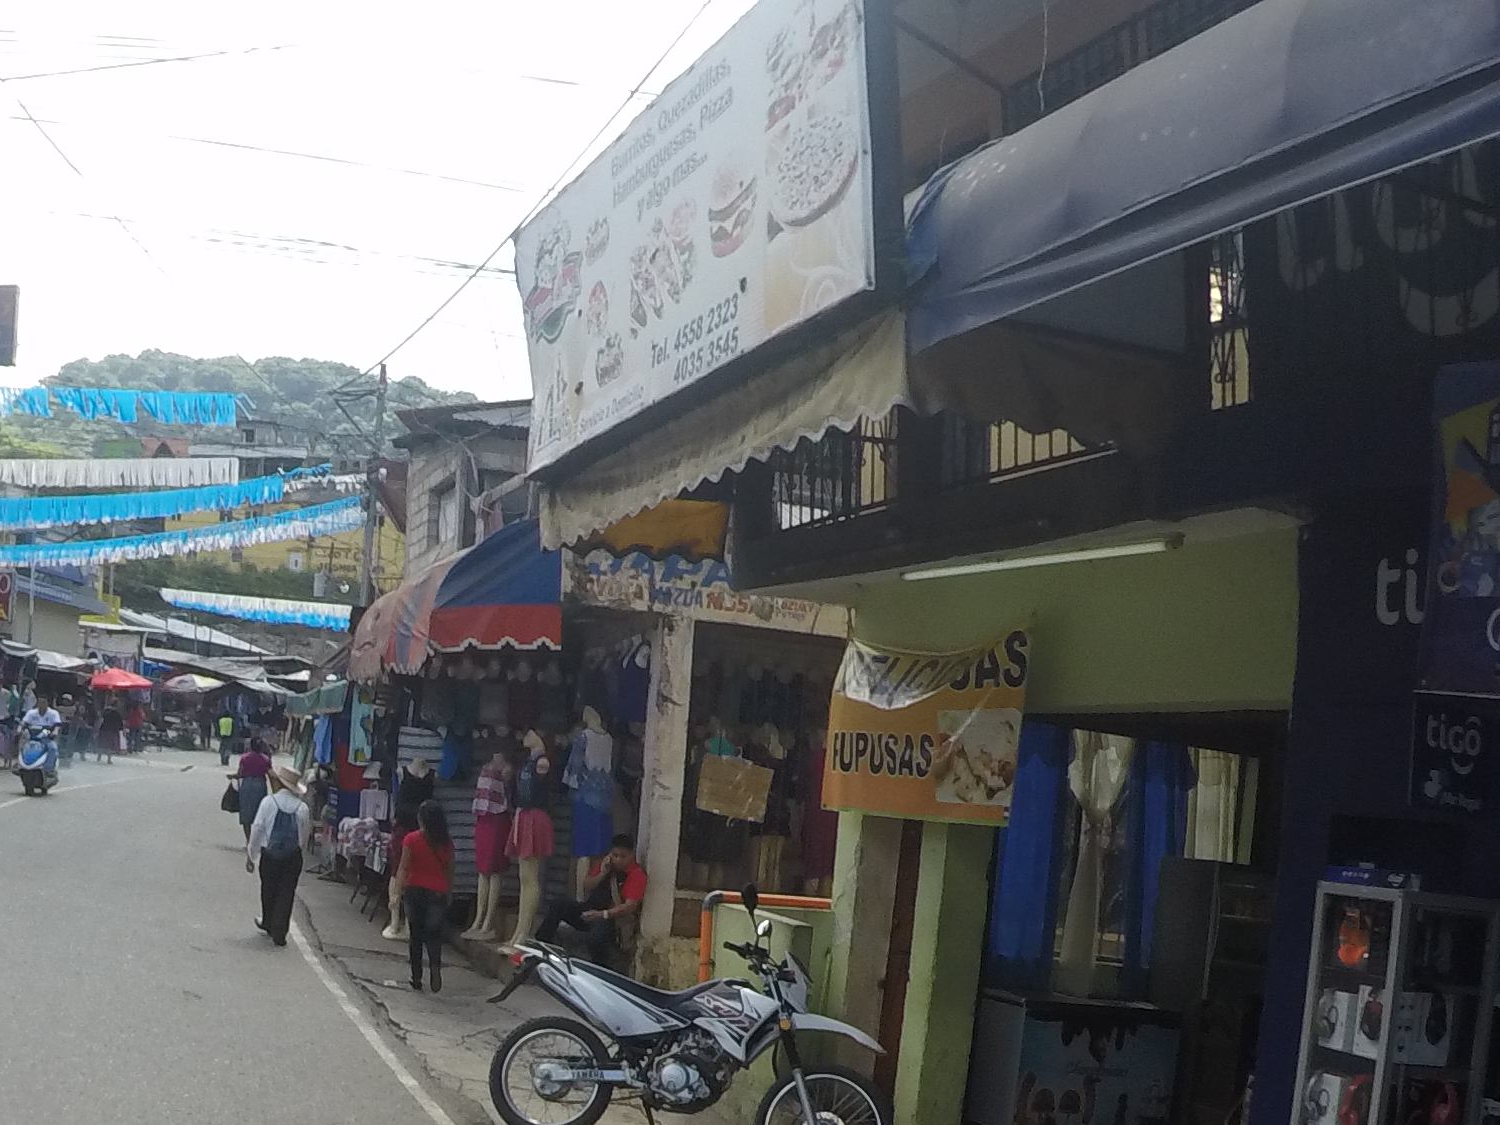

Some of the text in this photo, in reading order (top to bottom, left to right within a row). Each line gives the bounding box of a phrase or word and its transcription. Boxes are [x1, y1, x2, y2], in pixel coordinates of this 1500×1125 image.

[674, 313, 704, 352] 4558
[706, 293, 739, 335] 2323
[673, 326, 740, 383] 4035 3545
[571, 1071, 604, 1079] YAMAHA
